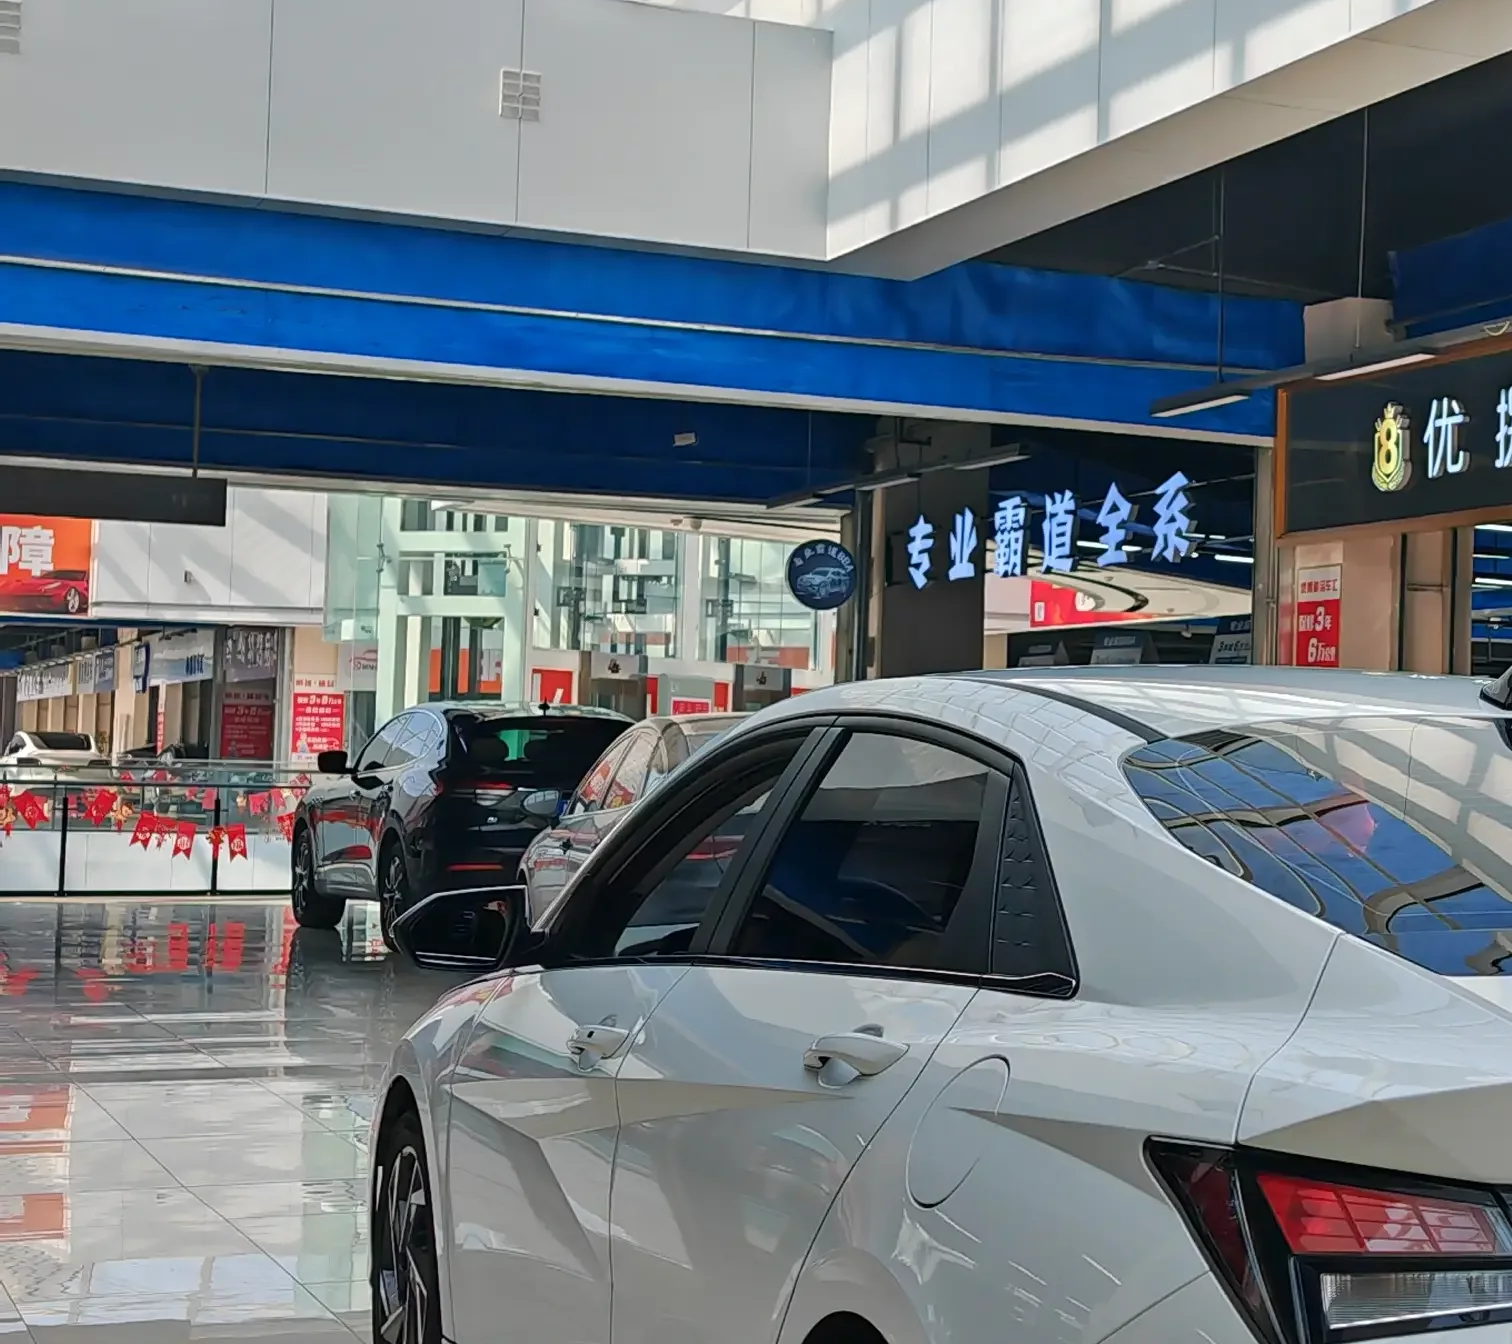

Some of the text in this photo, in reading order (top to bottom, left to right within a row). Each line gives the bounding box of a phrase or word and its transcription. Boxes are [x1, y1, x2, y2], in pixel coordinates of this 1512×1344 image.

[905, 471, 1197, 590] 专业霸道全系
